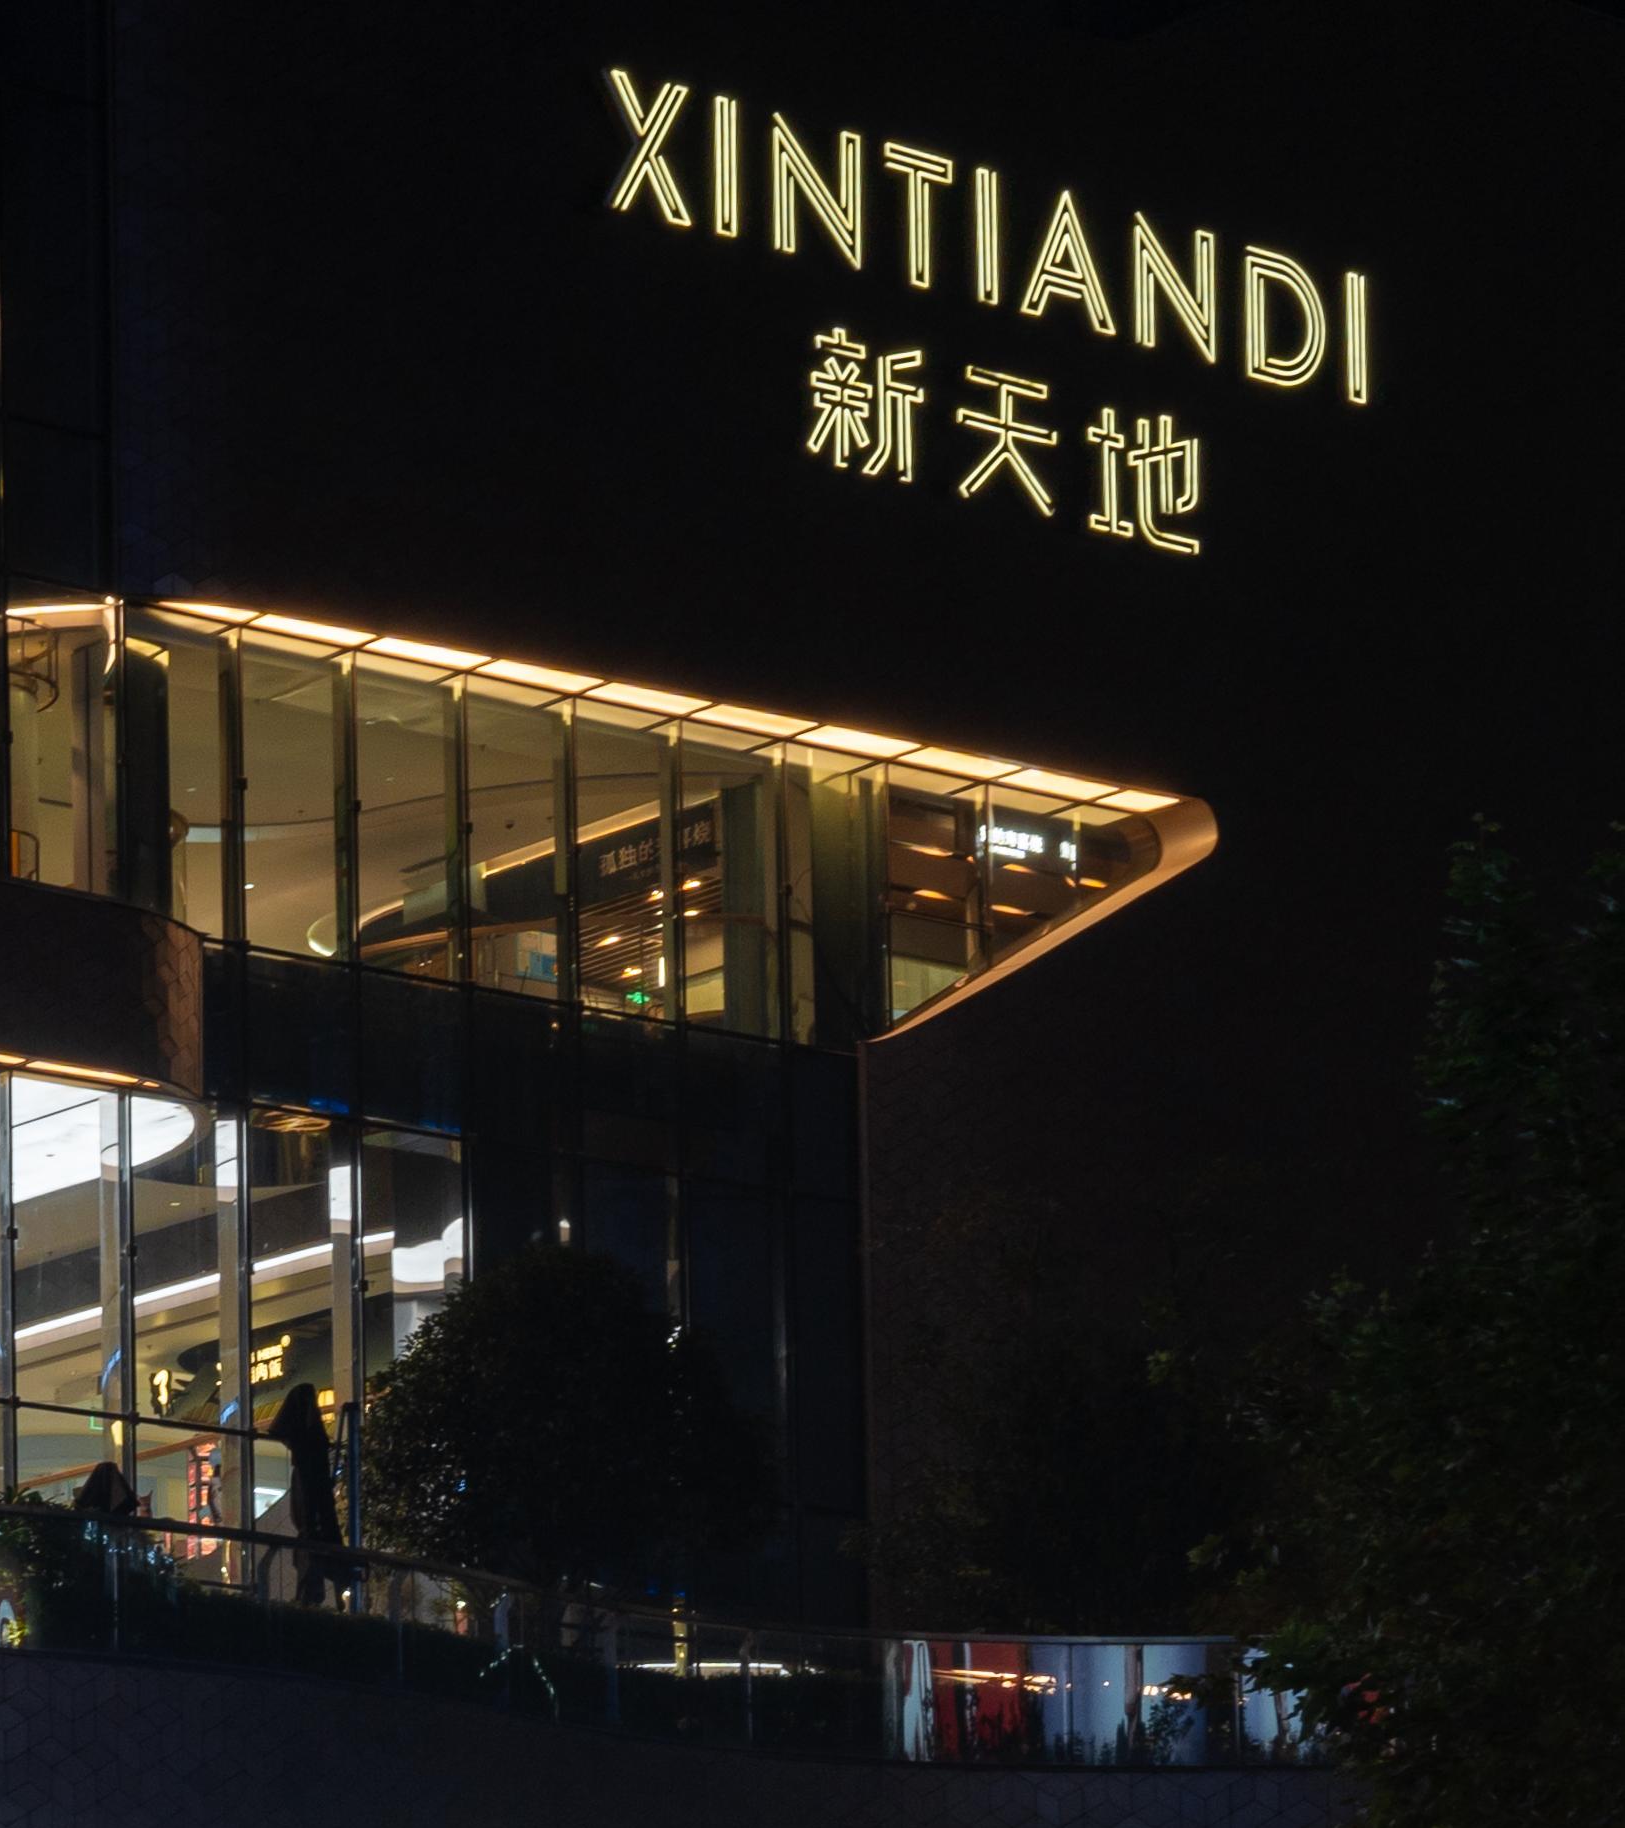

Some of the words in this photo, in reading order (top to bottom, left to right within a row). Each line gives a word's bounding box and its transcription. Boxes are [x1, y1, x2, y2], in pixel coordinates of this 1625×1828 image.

[607, 67, 1369, 405] XINTIANDI
[805, 328, 1201, 556] 新天地
